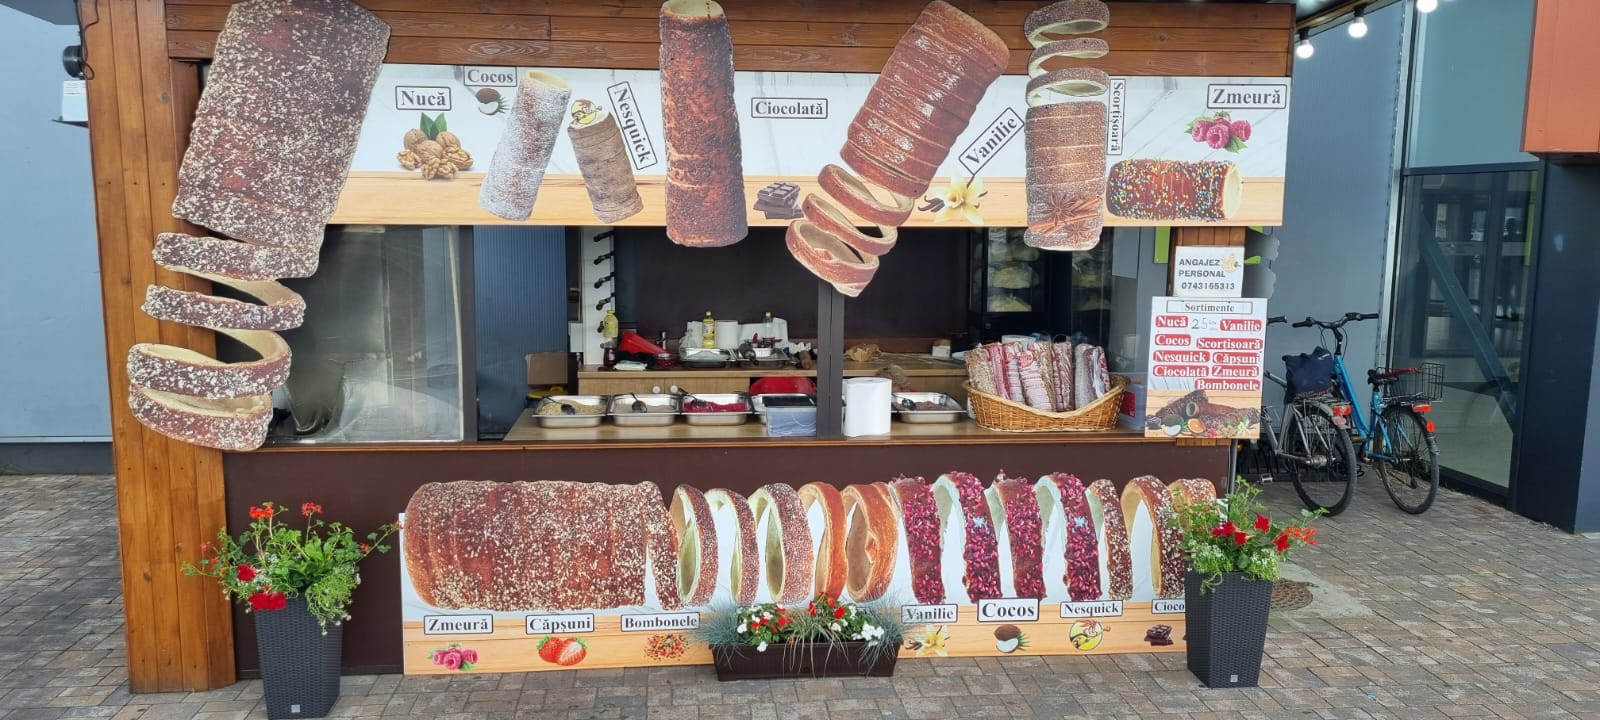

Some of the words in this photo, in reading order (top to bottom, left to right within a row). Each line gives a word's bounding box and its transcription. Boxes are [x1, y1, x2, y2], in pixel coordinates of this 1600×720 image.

[467, 69, 514, 83] Cocos
[400, 90, 446, 106] Nucă
[1212, 88, 1281, 104] Zmeură
[755, 101, 824, 115] Ciocolată
[613, 86, 652, 163] Nesquick
[965, 115, 1018, 166] Vanilie
[1178, 258, 1220, 266] ANGAJEZ
[1178, 270, 1226, 278] PERSONAL
[1184, 303, 1235, 313] Sortimente
[1157, 316, 1187, 327] Nucă
[1191, 318, 1208, 330] 25
[1221, 320, 1260, 331] Vanilie
[1156, 335, 1190, 346] Cocos
[1154, 351, 1207, 363] Nesquick
[1154, 366, 1207, 377] Ciocolată
[1212, 366, 1258, 377] Zmeură
[1196, 380, 1259, 391] Bombonele
[905, 606, 954, 620] Vanilie
[982, 602, 1035, 619] Cocos
[1064, 602, 1120, 618] Nesquick
[428, 616, 489, 632] Zmeură
[529, 615, 591, 633] Căpșuni
[625, 615, 698, 630] Bombonele
